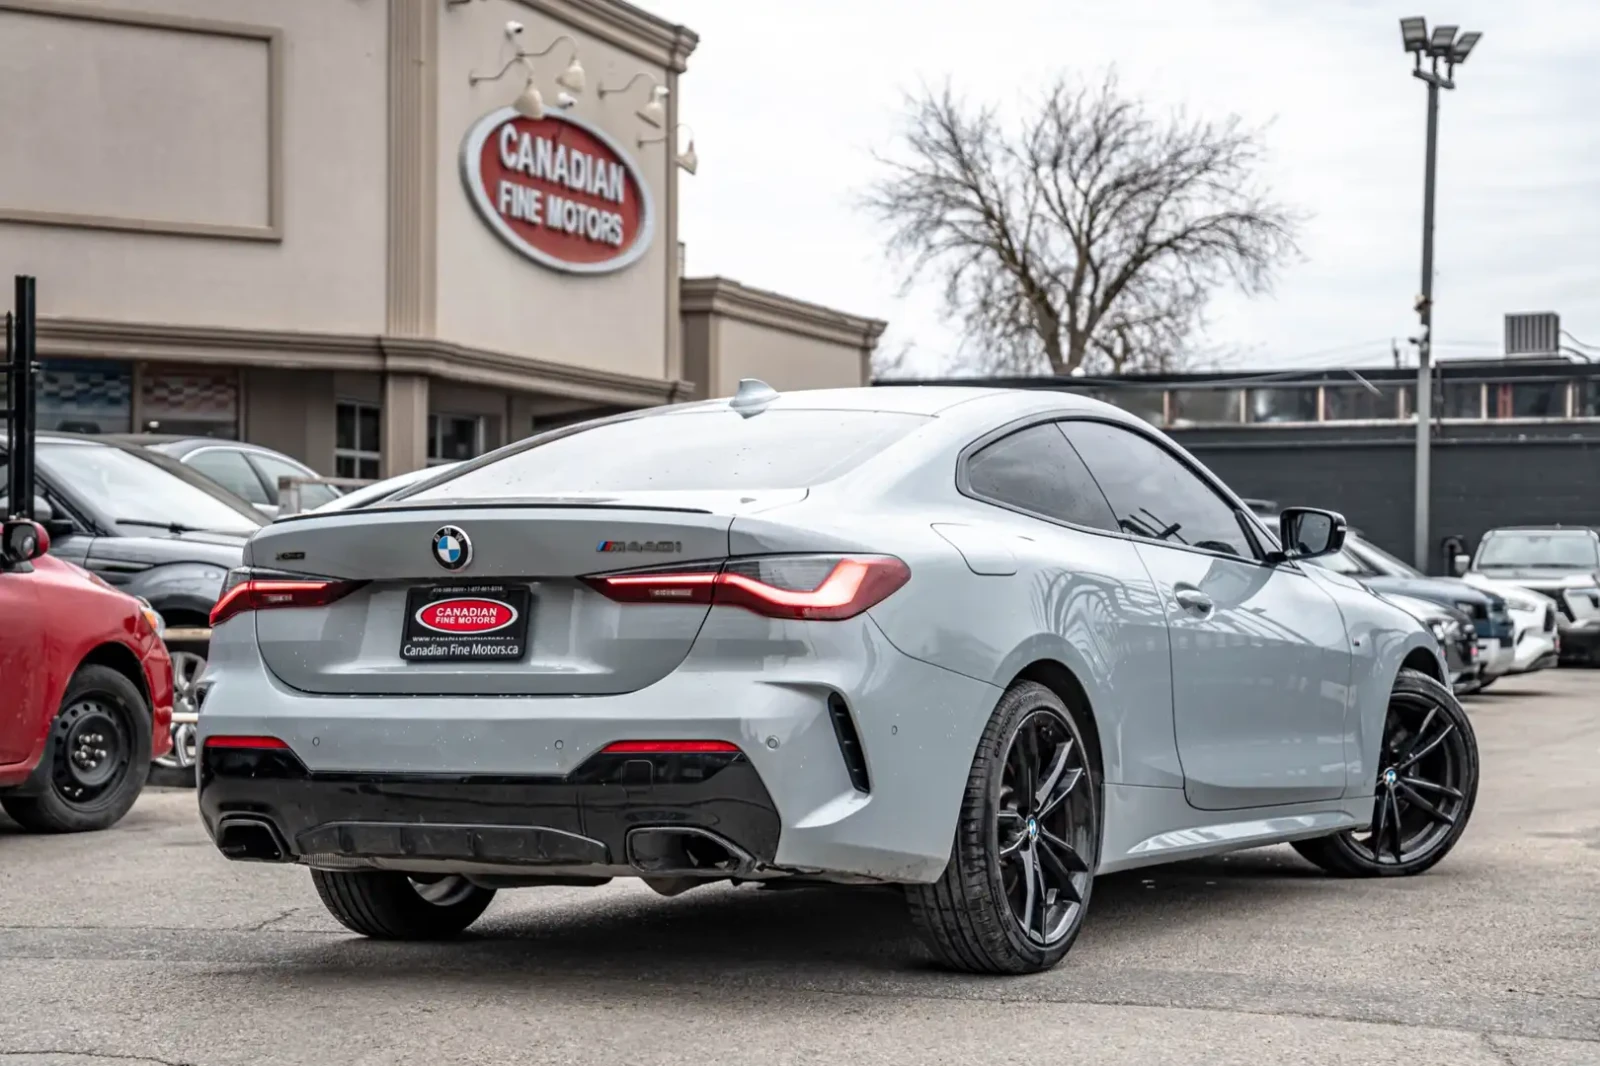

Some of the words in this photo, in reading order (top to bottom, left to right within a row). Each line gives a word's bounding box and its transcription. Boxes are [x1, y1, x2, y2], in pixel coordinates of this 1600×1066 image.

[500, 123, 625, 203] CANADIAN
[498, 181, 542, 224] FINE
[547, 196, 623, 246] MOTORS
[436, 607, 497, 616] CANADIAN
[435, 616, 455, 624] FINE
[458, 616, 496, 624] MOTORS
[403, 643, 448, 656] Canadian
[450, 643, 470, 655] Fine
[471, 643, 519, 655] Motors.ca
